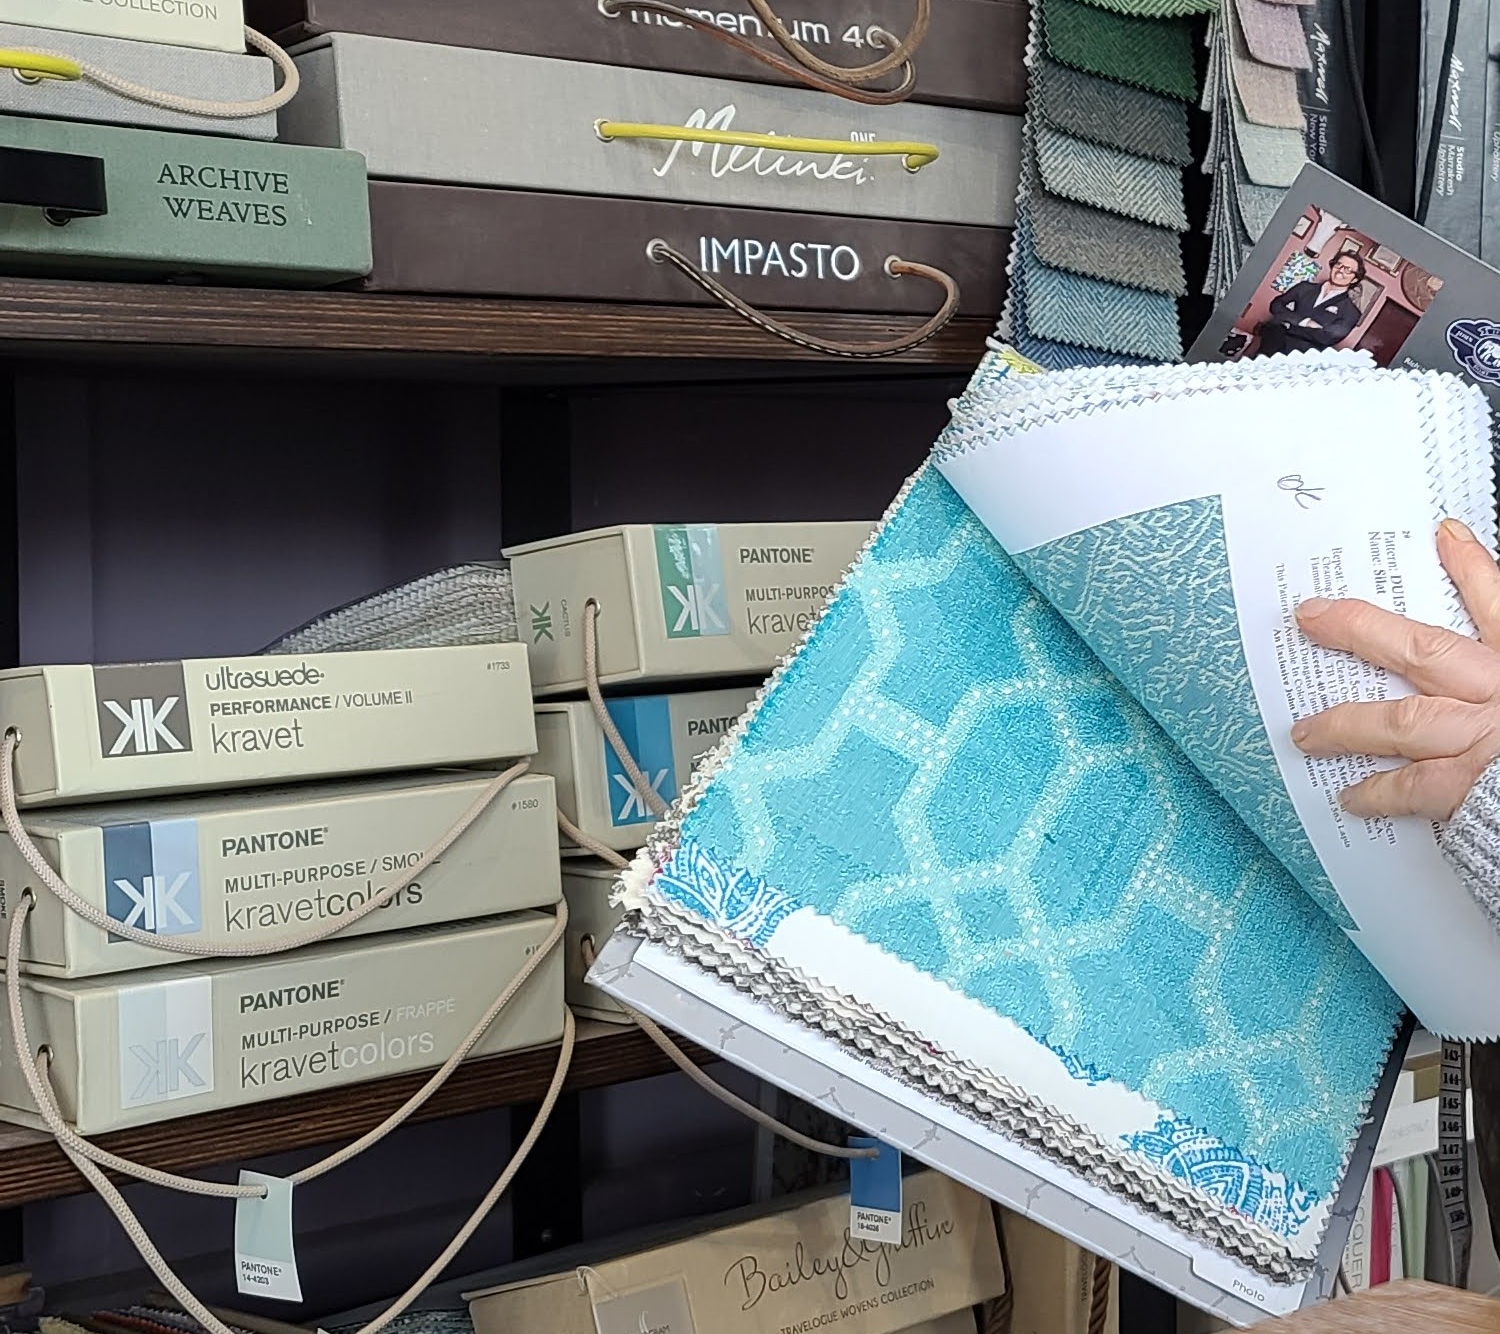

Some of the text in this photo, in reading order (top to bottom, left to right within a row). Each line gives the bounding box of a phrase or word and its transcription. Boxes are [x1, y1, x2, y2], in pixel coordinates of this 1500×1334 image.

[1310, 23, 1332, 106] Maxwell
[1447, 53, 1465, 131] Maxwell
[1310, 113, 1318, 139] New
[1318, 115, 1328, 155] Studio
[156, 162, 289, 195] ARCHIVE
[1436, 143, 1447, 197] Upholstery
[1446, 144, 1456, 196] Marrakesh
[1456, 146, 1465, 182] Studio
[162, 196, 287, 227] WEAVES
[699, 236, 860, 280] IMPASTO
[1330, 546, 1345, 582] Repeat:
[1367, 530, 1387, 594] Name: Silat
[1383, 530, 1400, 571] Pattern:
[1275, 562, 1286, 581] This
[745, 586, 835, 602] MULTI-PURPOS
[1277, 583, 1290, 613] Pattern
[560, 599, 571, 637] CACTUS
[1320, 556, 1347, 685] Cleaning Clean
[1283, 625, 1299, 665] Available
[1290, 666, 1301, 677] In
[209, 696, 331, 716] PERFORMANCE
[342, 692, 402, 708] VOLUME
[1272, 628, 1318, 788] An Exclusive John Pattern
[211, 719, 304, 754] kravet
[511, 798, 539, 811] #1580
[1324, 788, 1336, 805] and
[224, 861, 367, 893] MULTI-PURPOSE
[241, 1014, 380, 1050] MULTI-PURPOSE
[240, 1027, 434, 1089] kravetcolors
[840, 1298, 879, 1319] WOVENS
[880, 1278, 935, 1304] COLLECTION
[1231, 1278, 1266, 1302] Photo
